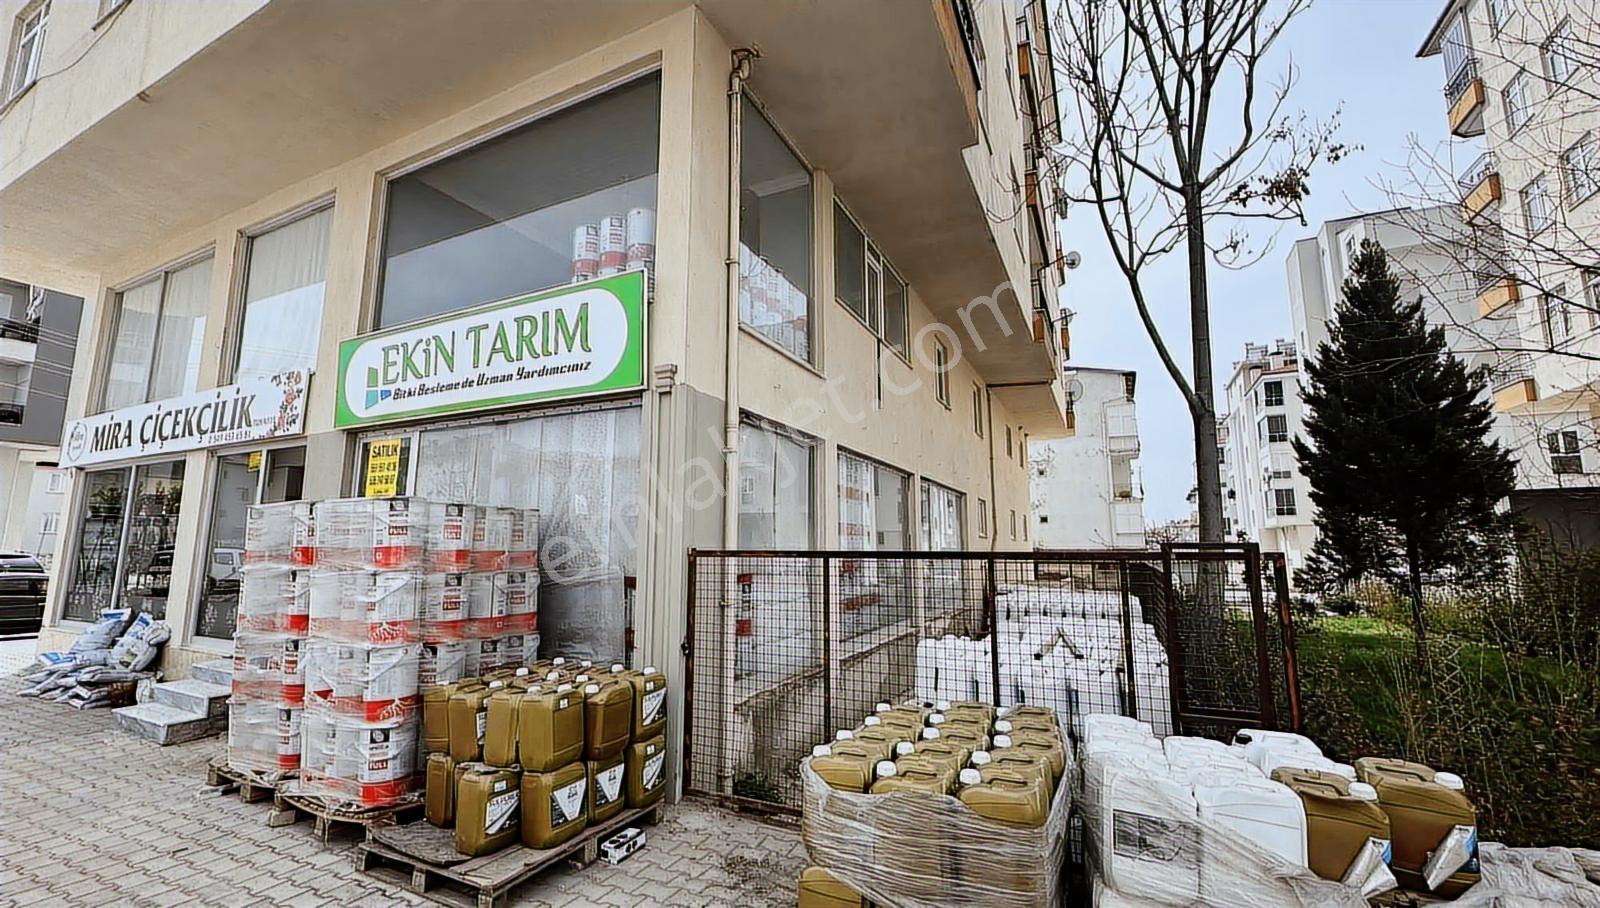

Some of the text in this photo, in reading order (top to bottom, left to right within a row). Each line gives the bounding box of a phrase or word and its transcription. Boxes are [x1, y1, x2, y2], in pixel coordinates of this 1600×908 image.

[465, 302, 592, 369] TARIM
[393, 387, 417, 401] Bitki
[476, 373, 514, 387] Uzman
[515, 361, 593, 381] Yardımcınız
[89, 387, 257, 454] MİRA ÇİÇEKÇİLİK
[372, 444, 399, 458] SATILIK
